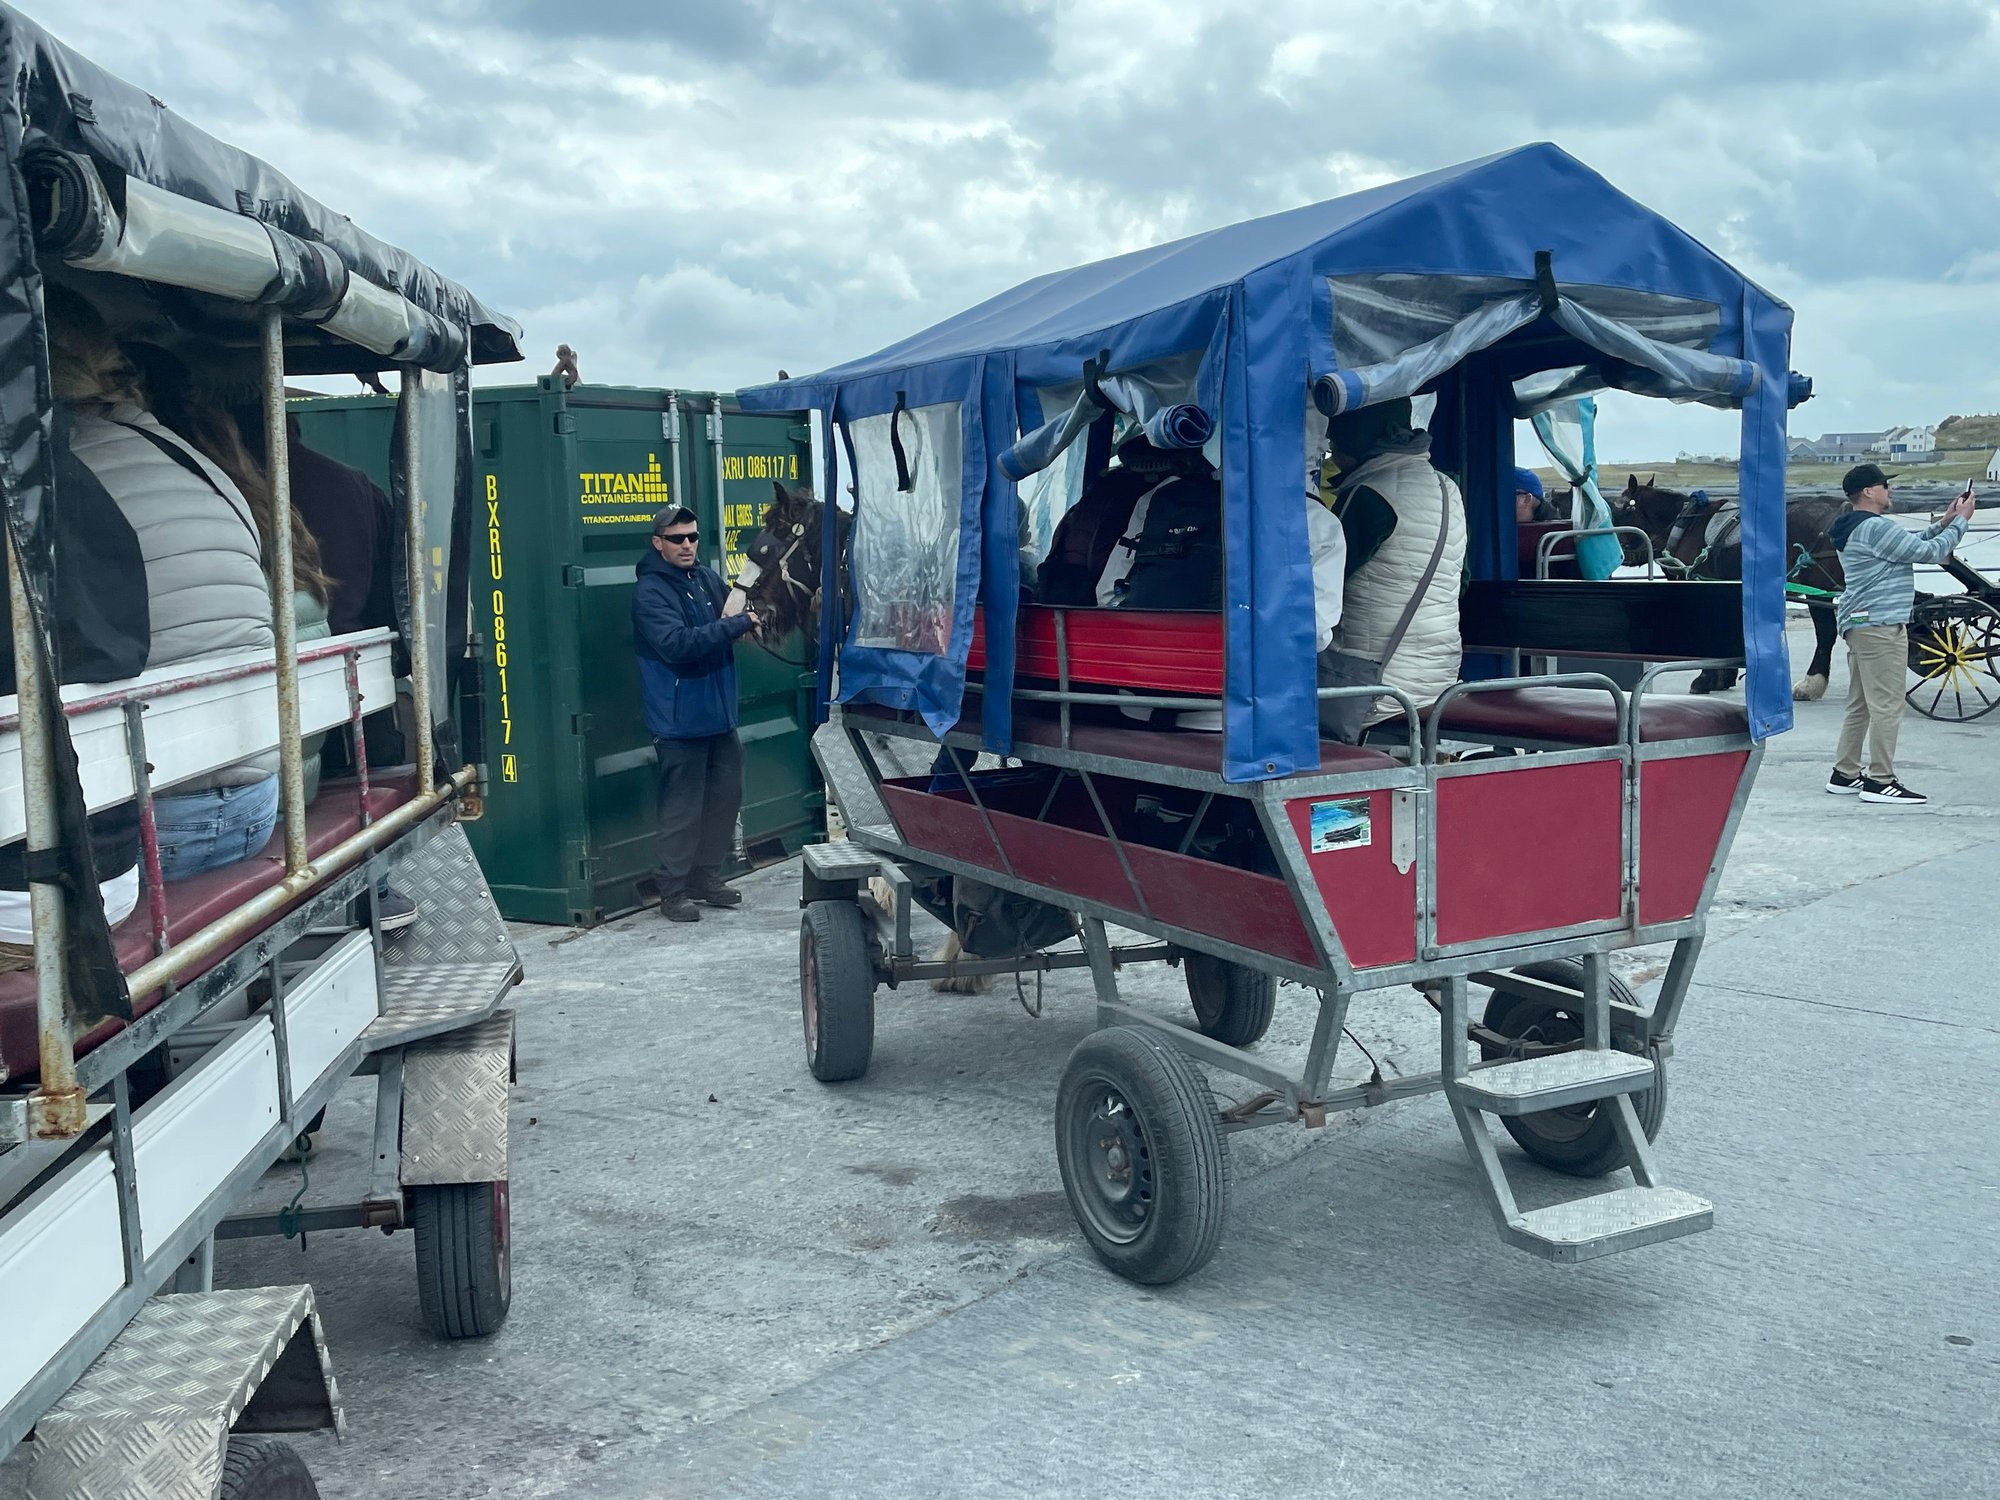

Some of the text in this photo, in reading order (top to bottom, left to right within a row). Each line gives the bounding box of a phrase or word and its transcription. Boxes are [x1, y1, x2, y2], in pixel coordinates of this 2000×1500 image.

[722, 454, 798, 480] XRU 086117 4
[579, 473, 644, 493] TITAN
[580, 494, 645, 504] CONTAINERS
[582, 514, 656, 525] TITANCONTAINERS.
[736, 504, 753, 527] GROSS
[486, 474, 518, 782] BXRU 086117 4
